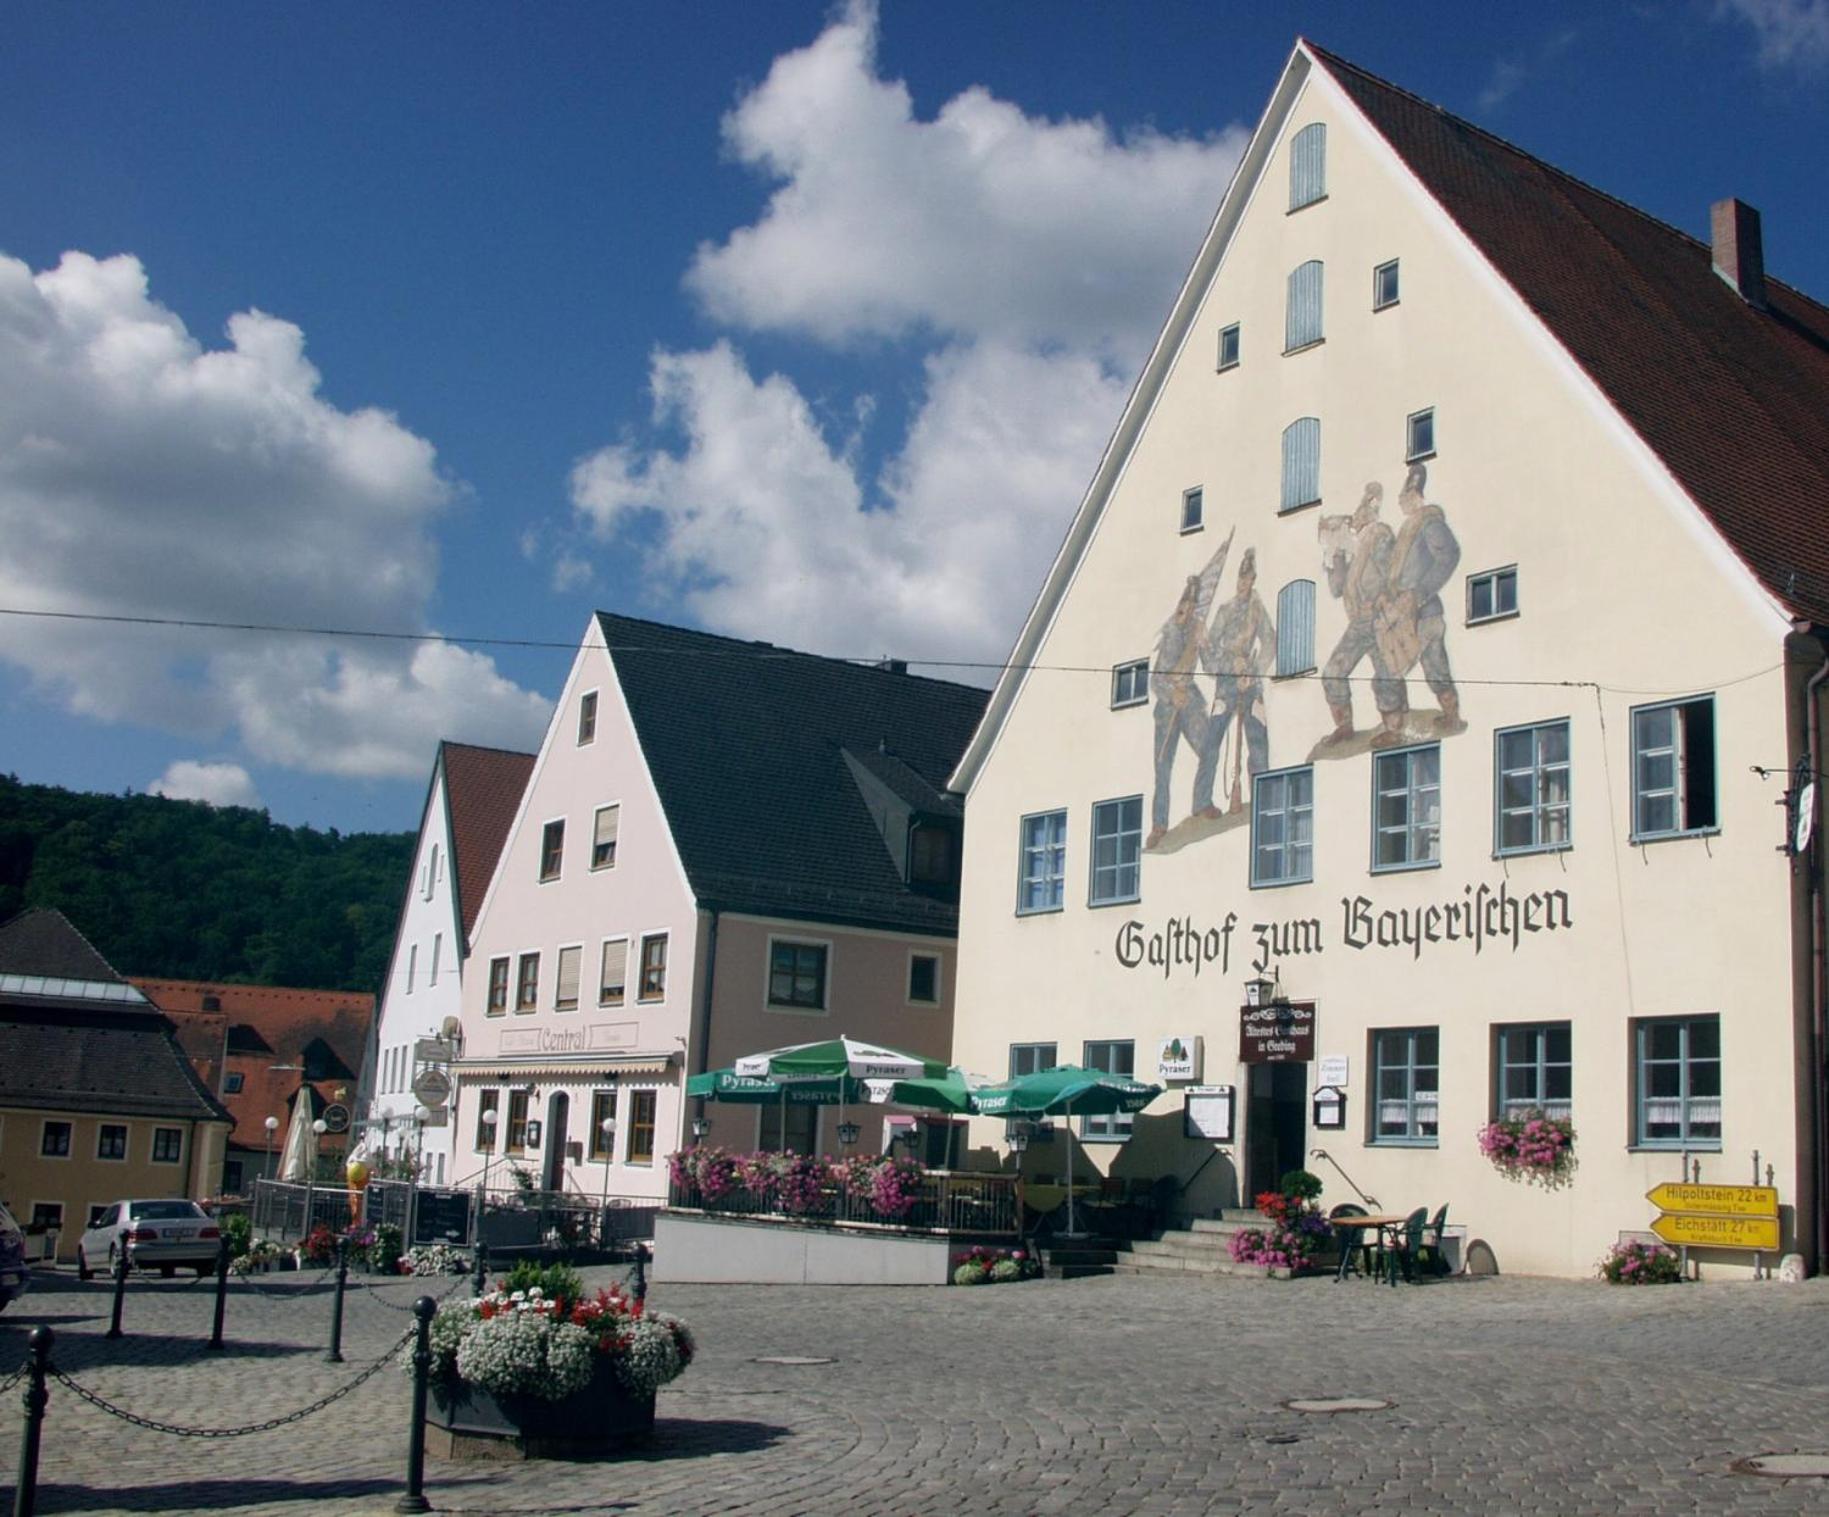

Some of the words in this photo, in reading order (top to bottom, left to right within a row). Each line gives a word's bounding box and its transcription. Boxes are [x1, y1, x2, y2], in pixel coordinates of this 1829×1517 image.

[1115, 911, 1238, 980] Gasthof
[1252, 918, 1323, 973] zum
[1341, 880, 1573, 961] Bayerischen
[541, 1024, 586, 1051] Central
[866, 1065, 906, 1075] Pyraser
[1159, 1063, 1191, 1076] Pyraser
[1666, 1186, 1734, 1201] Hilpoltstein
[1738, 1189, 1752, 1202] 22
[1755, 1193, 1767, 1202] km
[1731, 1220, 1746, 1233] 27
[1748, 1222, 1761, 1233] km
